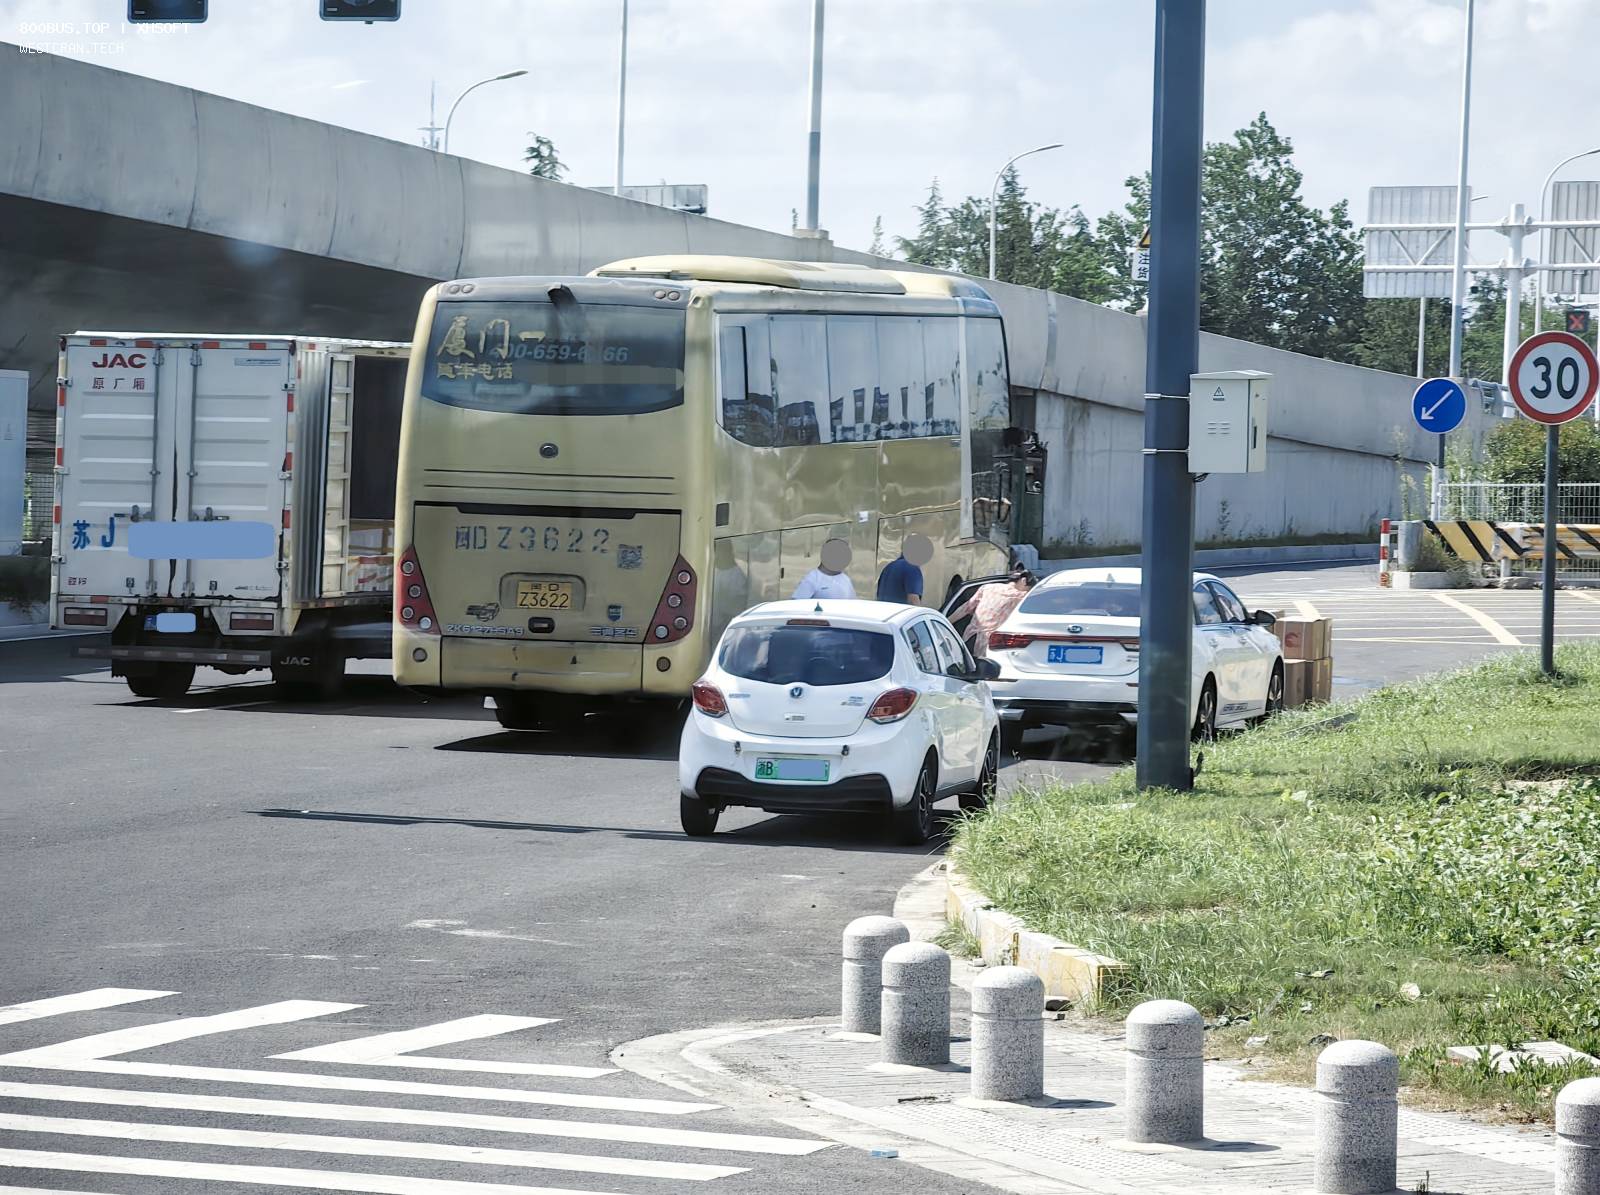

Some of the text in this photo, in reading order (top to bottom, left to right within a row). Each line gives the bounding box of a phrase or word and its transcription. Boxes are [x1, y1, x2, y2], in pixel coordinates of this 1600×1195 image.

[91, 352, 147, 369] JAC
[92, 376, 146, 391] 原厂厢
[1530, 356, 1580, 400] 30
[71, 515, 116, 550] 苏J
[519, 592, 570, 608] Z3622
[279, 656, 312, 666] JAC
